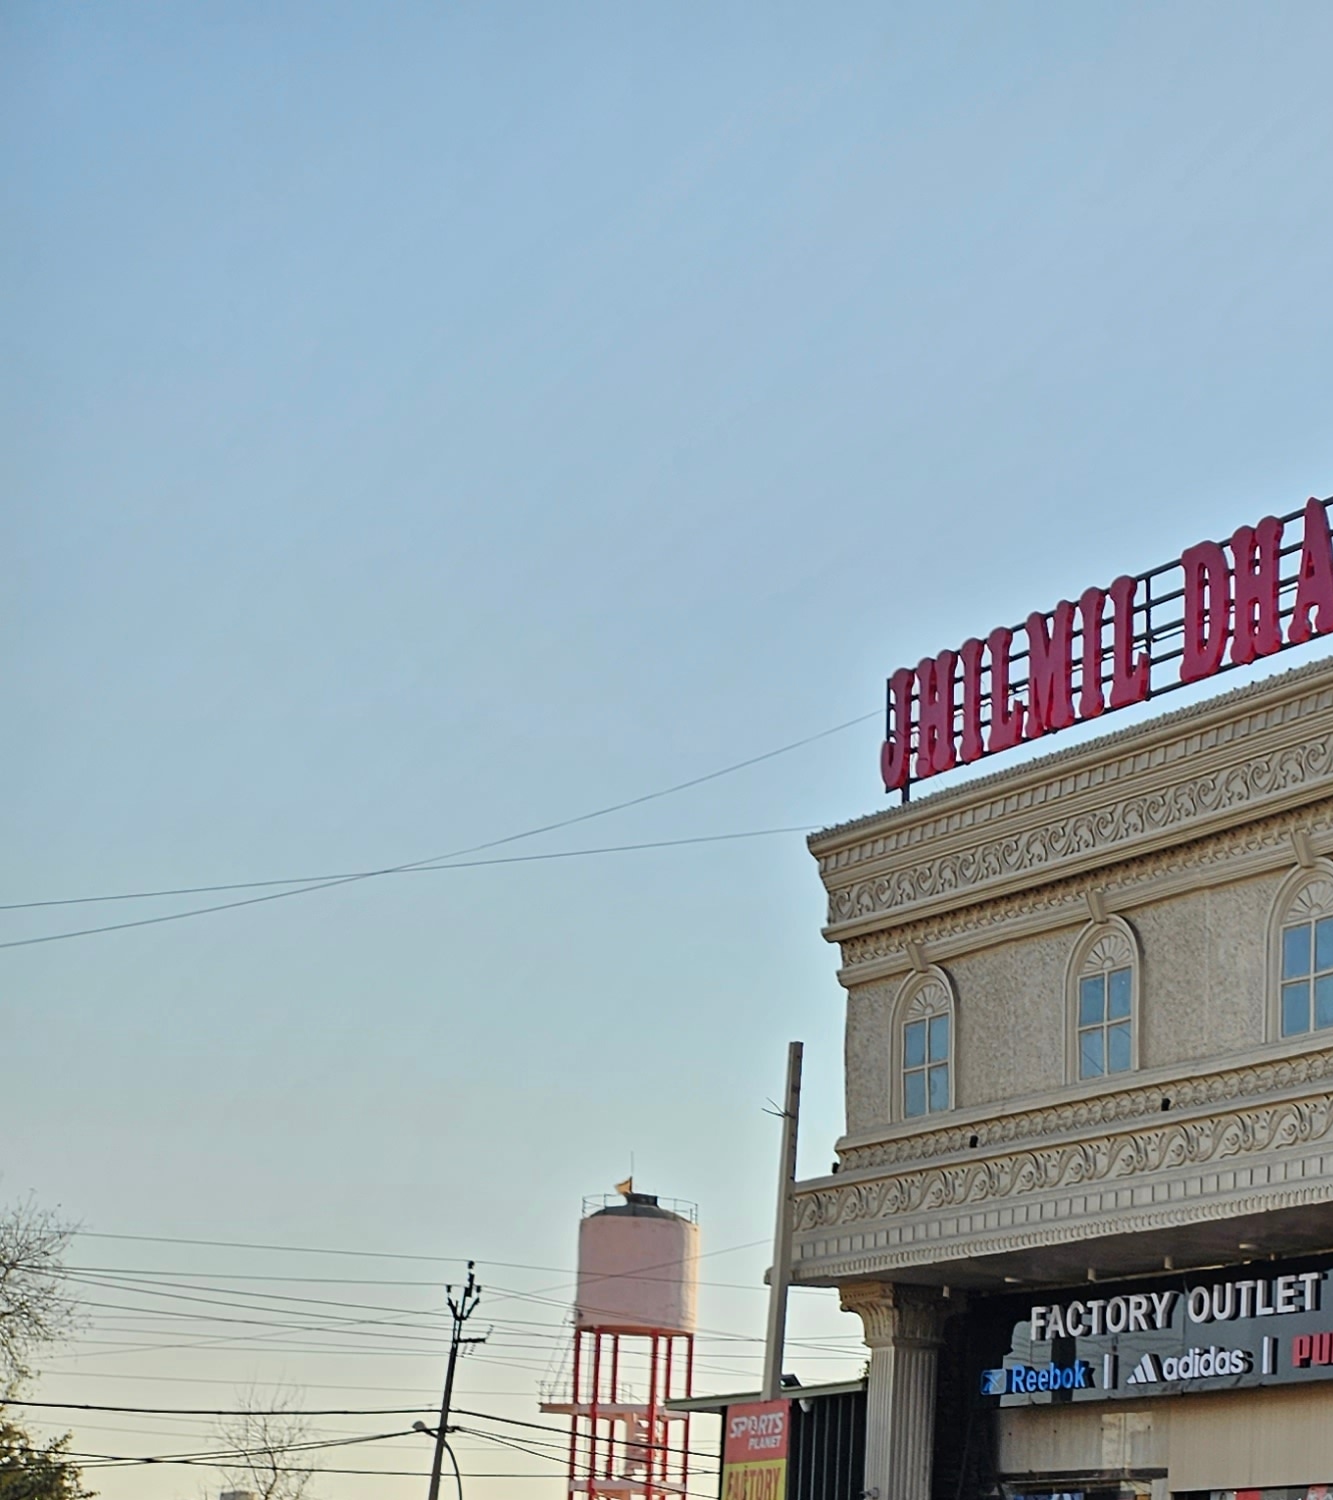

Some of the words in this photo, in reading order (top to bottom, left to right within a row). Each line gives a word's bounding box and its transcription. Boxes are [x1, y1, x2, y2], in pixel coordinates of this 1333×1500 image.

[881, 574, 1150, 789] JHILMIL
[1030, 1291, 1175, 1341] FACTORY
[1188, 1272, 1322, 1324] OUTLET
[1012, 1360, 1091, 1393] Reebok
[1162, 1345, 1247, 1381] adidas
[730, 1411, 784, 1438] SPORTS
[748, 1435, 782, 1450] PLANET
